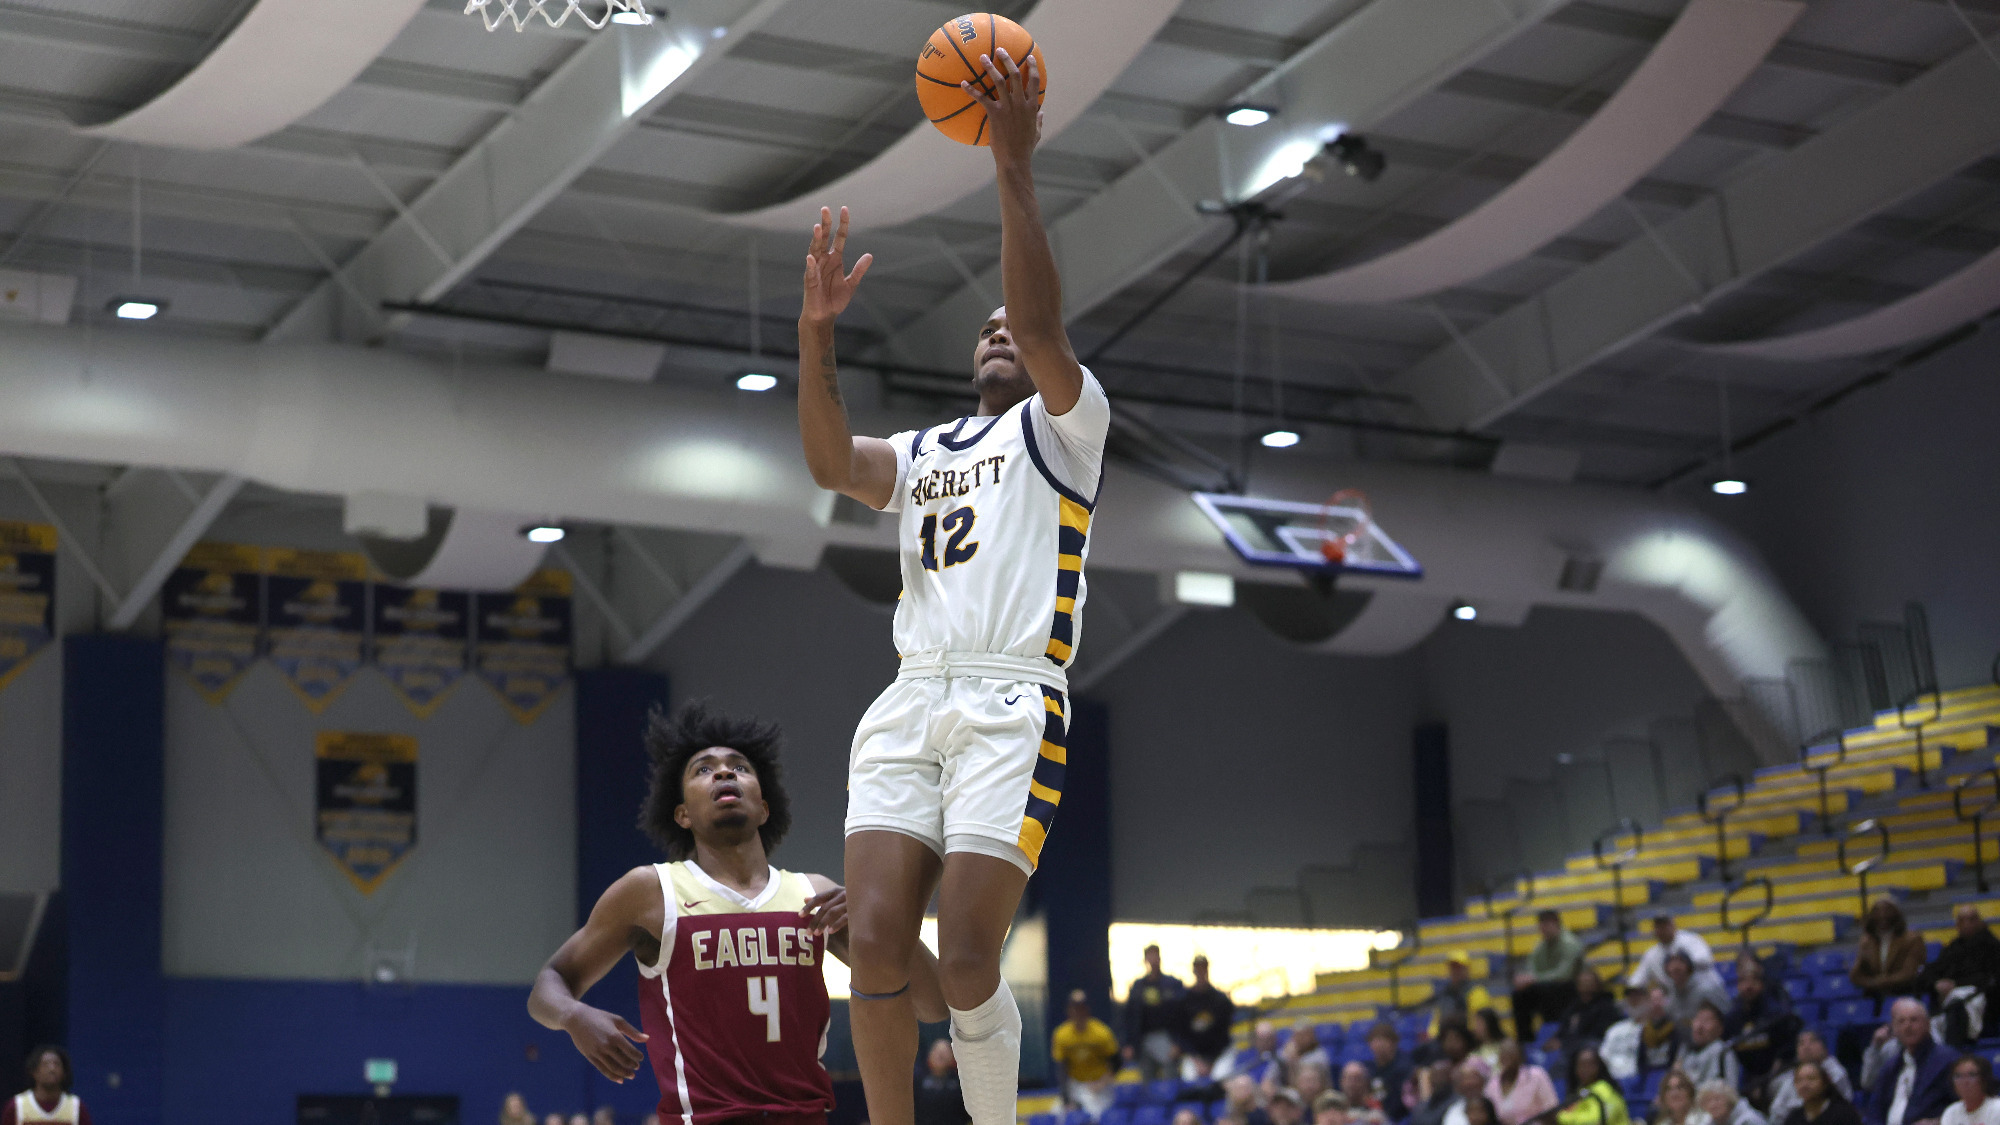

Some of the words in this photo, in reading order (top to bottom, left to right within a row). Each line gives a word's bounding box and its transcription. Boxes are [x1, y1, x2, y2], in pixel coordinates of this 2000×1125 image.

[919, 504, 980, 572] 12
[691, 926, 815, 971] EAGLES
[746, 975, 782, 1043] 4
